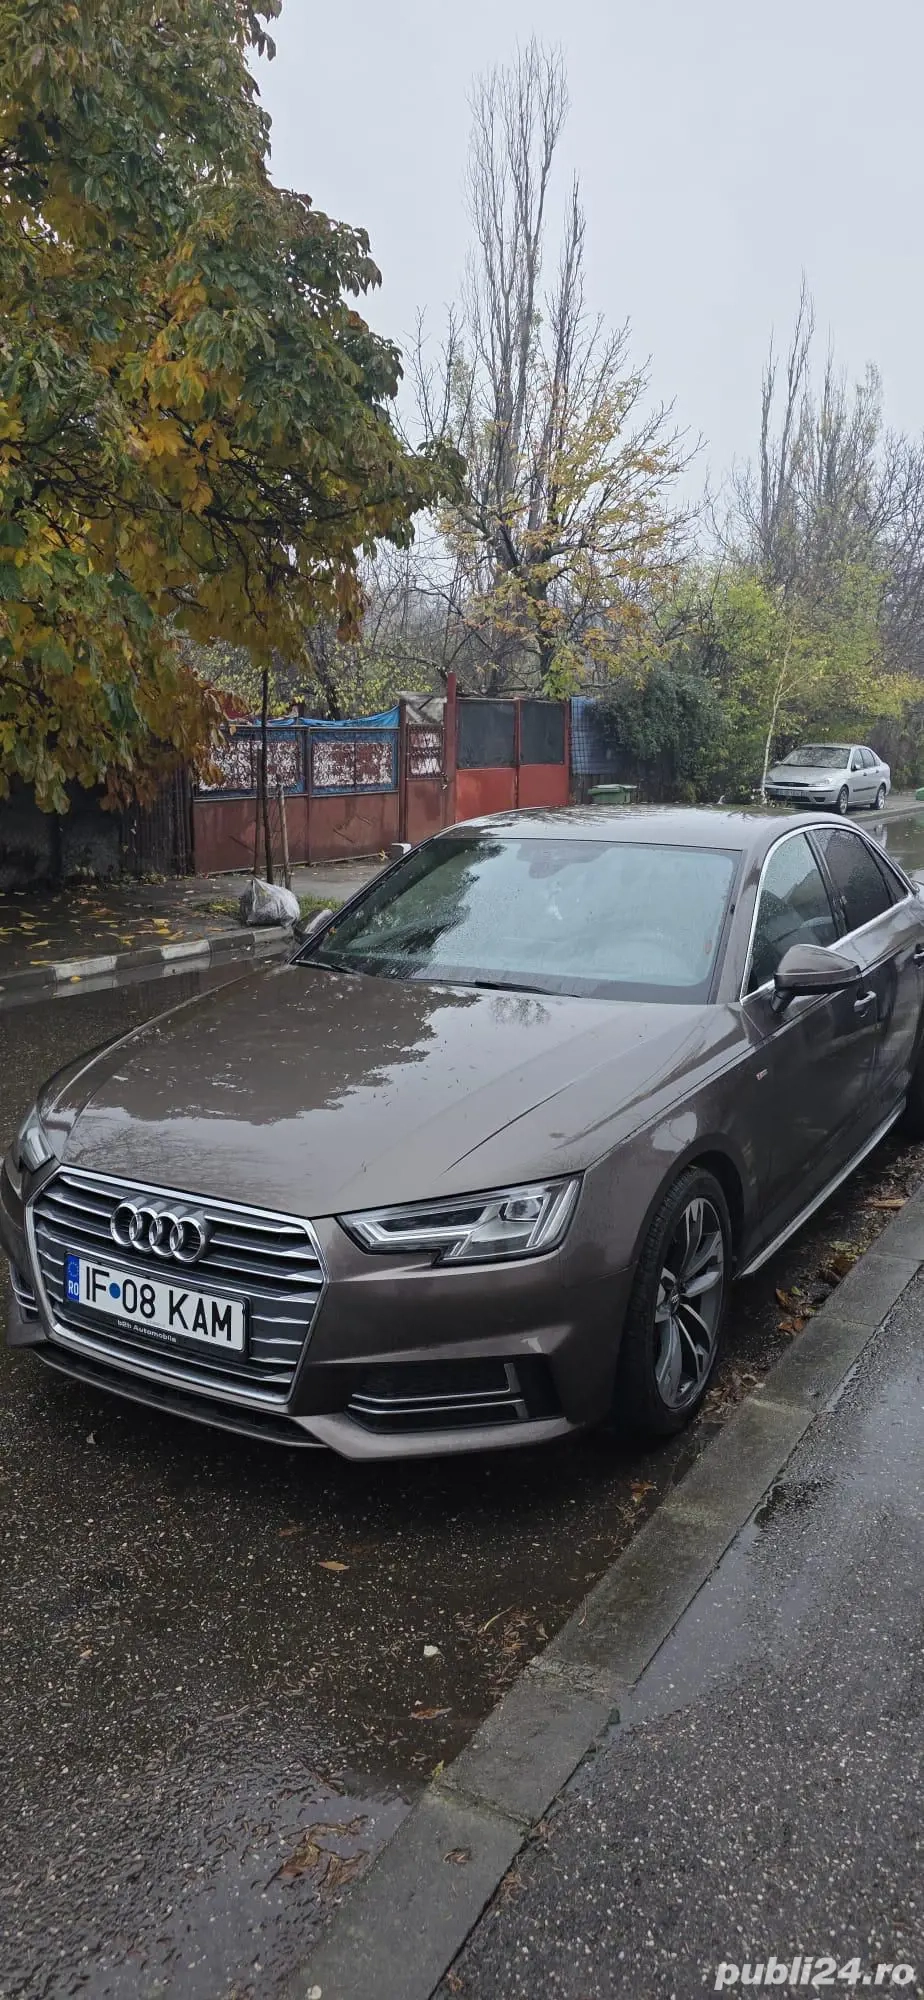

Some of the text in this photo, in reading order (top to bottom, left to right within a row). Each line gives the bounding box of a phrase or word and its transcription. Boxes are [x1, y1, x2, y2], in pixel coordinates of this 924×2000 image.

[68, 1279, 79, 1296] RO
[168, 1289, 232, 1342] KAM
[133, 1324, 177, 1343] Automobile
